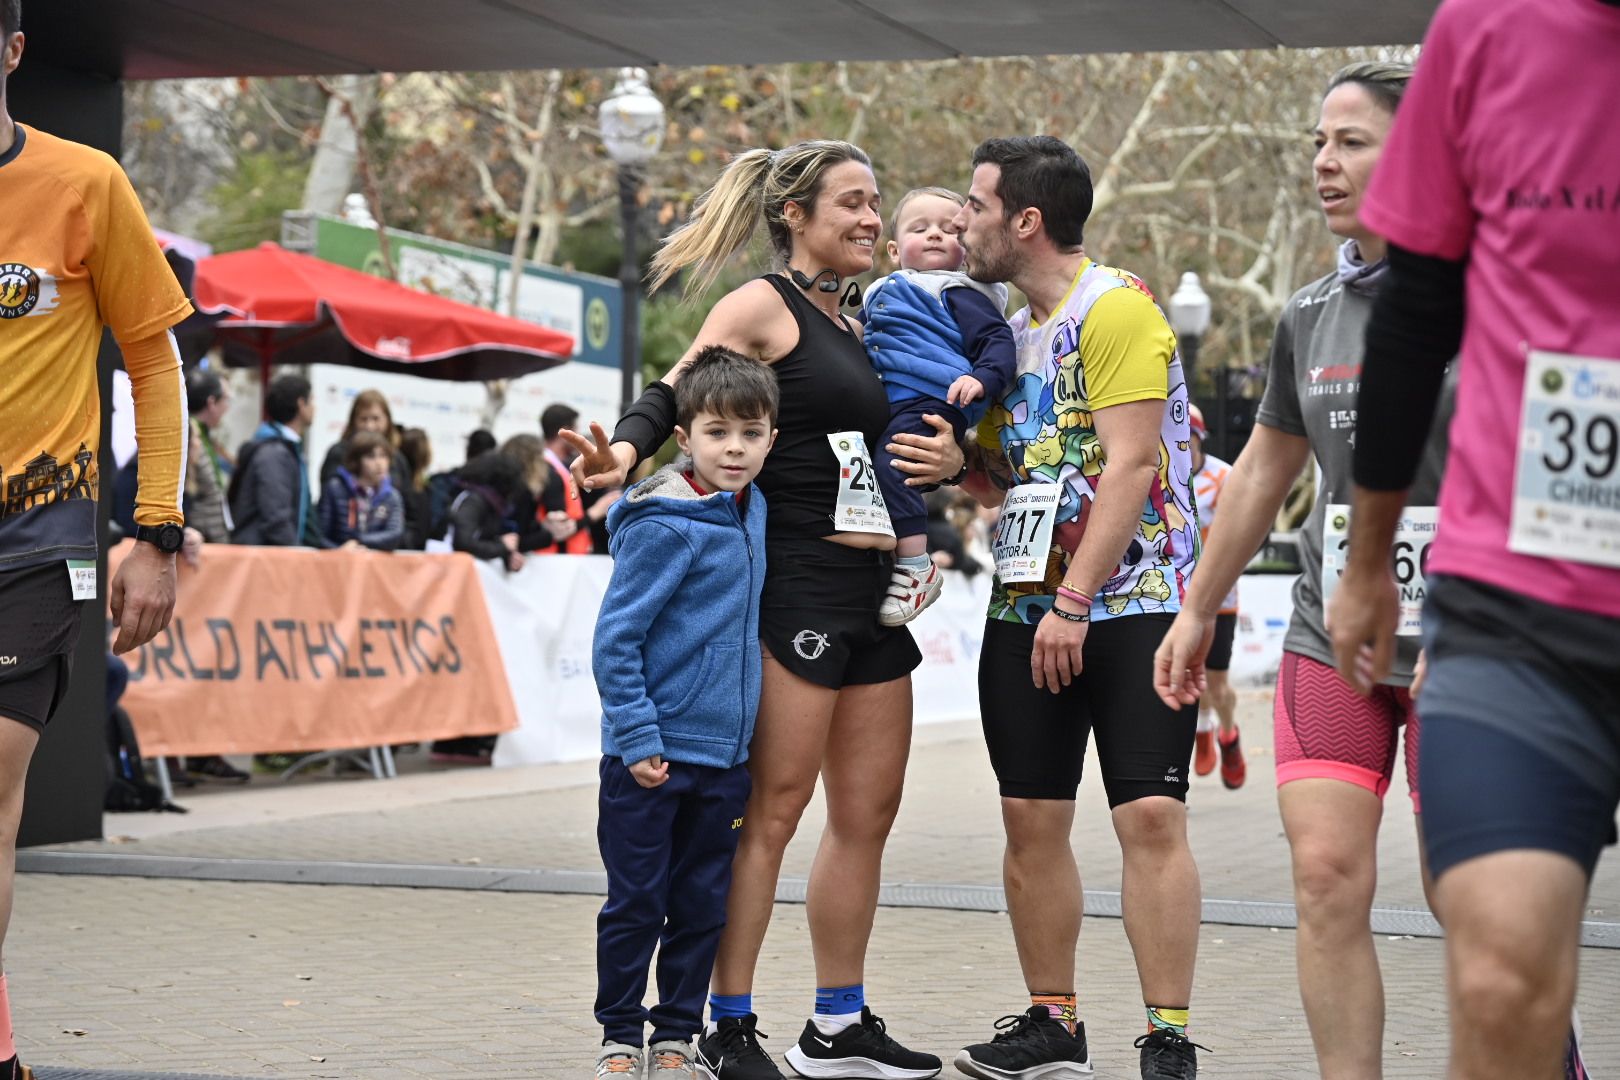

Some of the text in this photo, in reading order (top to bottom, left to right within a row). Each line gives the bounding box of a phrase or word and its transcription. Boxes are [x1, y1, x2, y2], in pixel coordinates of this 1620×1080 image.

[1308, 383, 1342, 397] TRAILS
[995, 509, 1046, 549] 2717
[1021, 544, 1031, 557] A.
[255, 615, 463, 681] ATHLETICS
